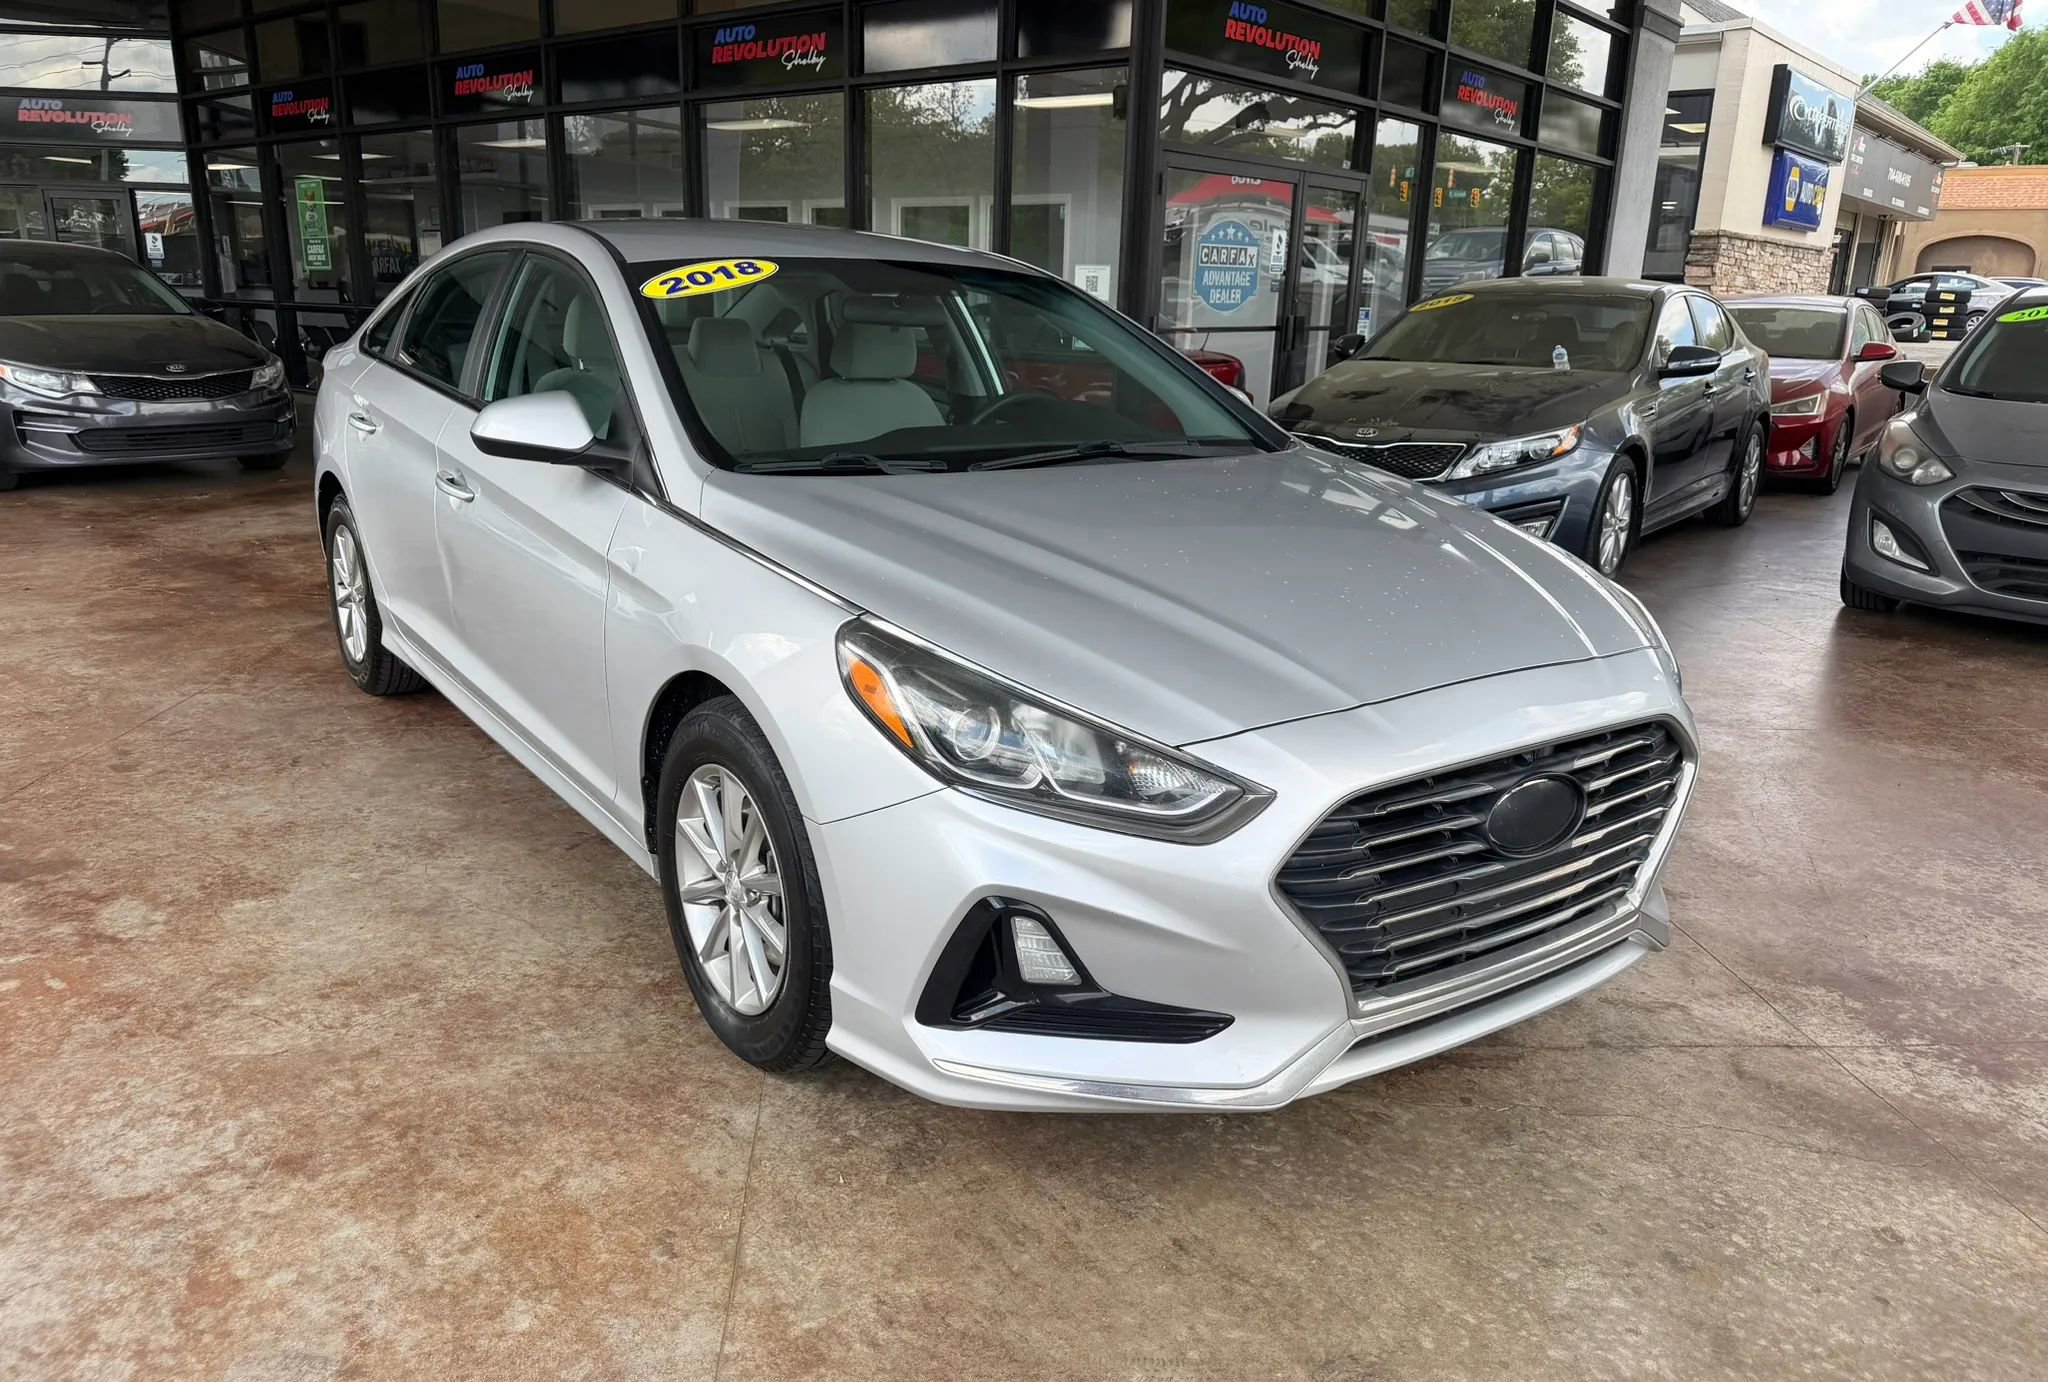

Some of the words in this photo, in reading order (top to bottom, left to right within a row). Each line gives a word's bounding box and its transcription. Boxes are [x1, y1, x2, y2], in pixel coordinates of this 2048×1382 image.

[1229, 1, 1267, 24] AUTO
[714, 25, 755, 44] AUTO
[1225, 18, 1321, 59] REVOLUTION
[712, 32, 826, 64] REVOLUTION
[781, 46, 826, 72] Shelby
[1285, 49, 1319, 80] Shelby
[456, 63, 484, 80] AUTO
[1461, 70, 1485, 89] AUTO
[455, 70, 534, 96] REVOLUTION
[503, 81, 534, 103] Shelby
[19, 99, 63, 110] AUTO
[272, 90, 293, 104] AUTO
[272, 97, 329, 117] REVOLUTION
[1457, 84, 1518, 116] REVOLUTION
[18, 109, 133, 124] REVOLUTION
[91, 120, 134, 137] Shelby
[1201, 247, 1256, 267] CARFAX
[659, 261, 763, 295] 2018
[1203, 270, 1251, 287] ADVANTAGE
[1210, 289, 1242, 304] DEALER
[2013, 309, 2048, 320] 20
